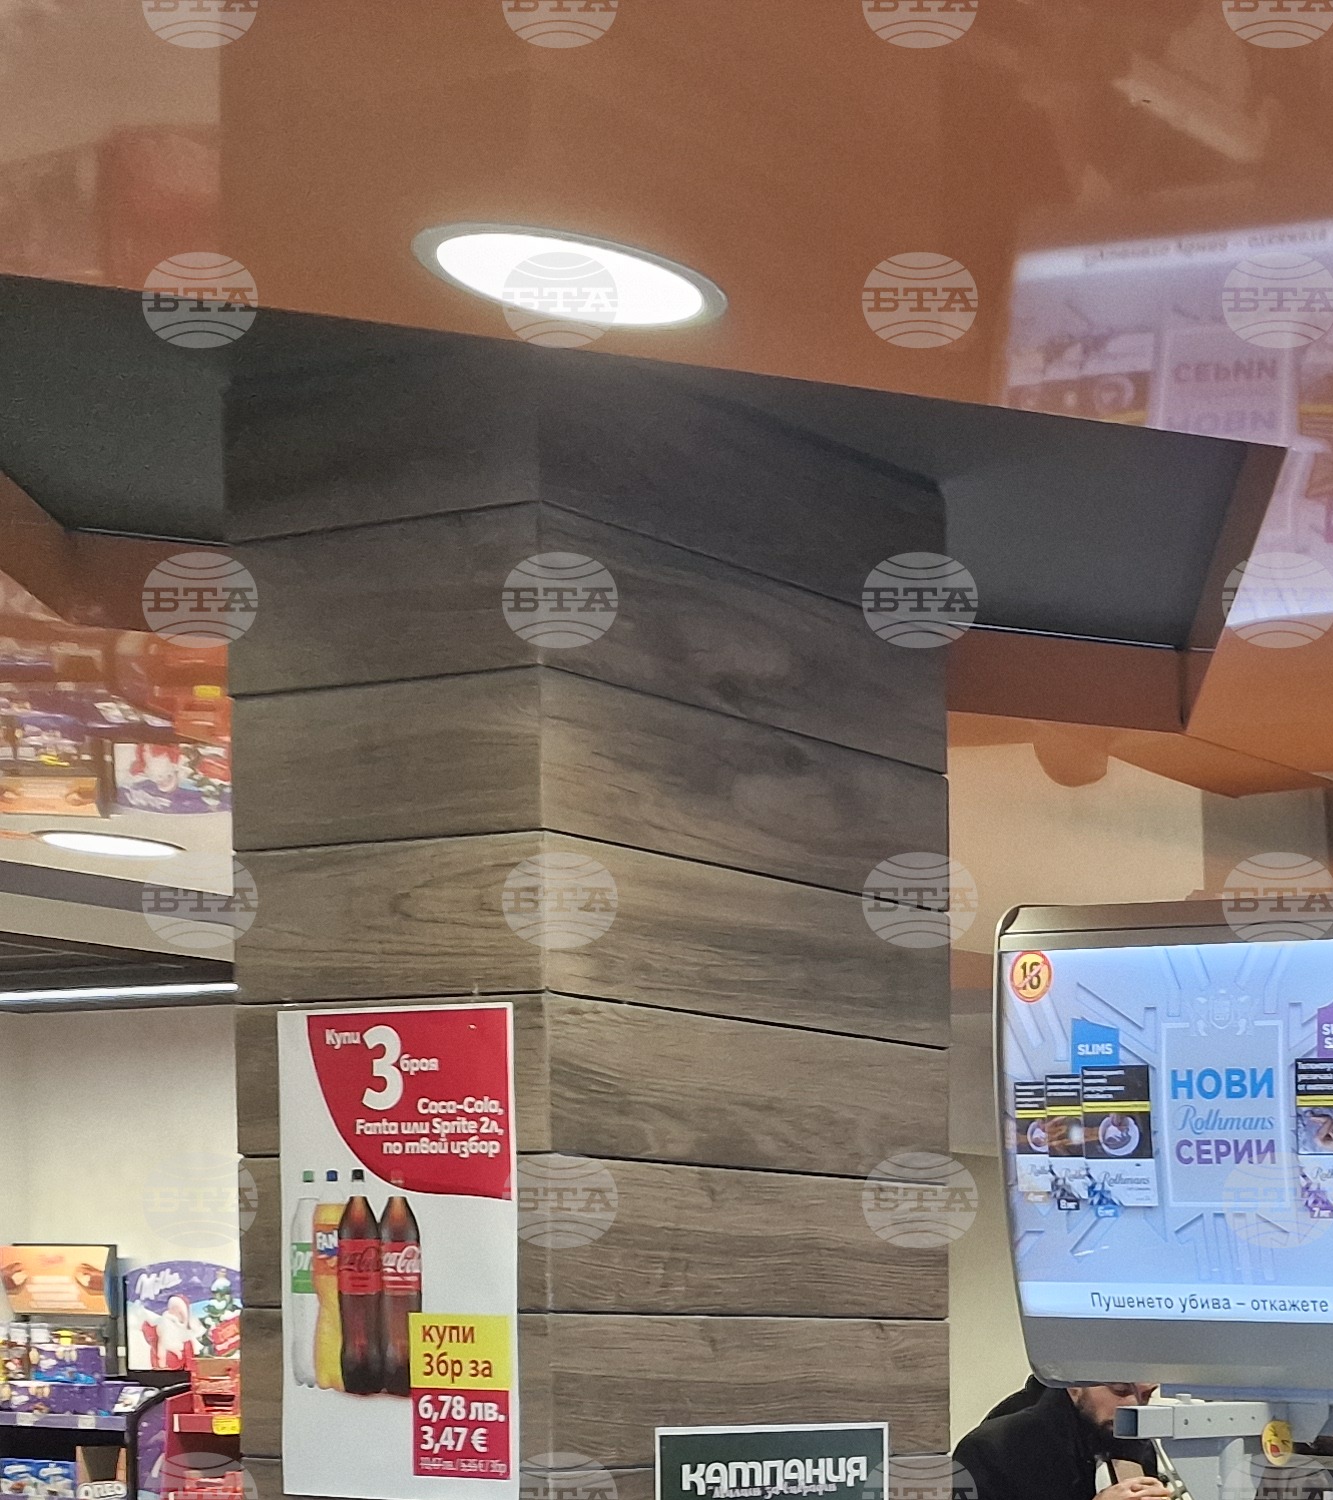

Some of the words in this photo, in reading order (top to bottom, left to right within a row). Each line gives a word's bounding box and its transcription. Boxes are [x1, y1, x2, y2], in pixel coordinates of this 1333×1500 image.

[1076, 1042, 1114, 1057] SLIMS
[325, 1029, 361, 1048] Купи
[362, 1024, 404, 1110] 3
[400, 1054, 439, 1075] броя
[1170, 1067, 1275, 1101] НОВИ
[417, 1096, 504, 1116] Coca-Cola,
[1175, 1104, 1275, 1135] Rothmans
[355, 1119, 399, 1135] Fanta
[401, 1121, 430, 1135] или
[432, 1116, 477, 1140] Sprite
[382, 1140, 403, 1155] по
[404, 1137, 449, 1154] твой
[451, 1136, 501, 1158] избор
[1174, 1137, 1277, 1166] СЕРИИ
[315, 1231, 339, 1249] FAN
[1090, 1291, 1174, 1313] Пушенето
[1177, 1293, 1233, 1314] убива
[1250, 1299, 1330, 1316] откажете
[421, 1325, 476, 1349] купи
[422, 1351, 464, 1383] 3бр
[468, 1360, 493, 1378] за
[418, 1394, 466, 1423] 6,78
[469, 1402, 506, 1422] лв.
[419, 1427, 469, 1454] 3,47
[681, 1456, 868, 1496] КАМПАНИЯ
